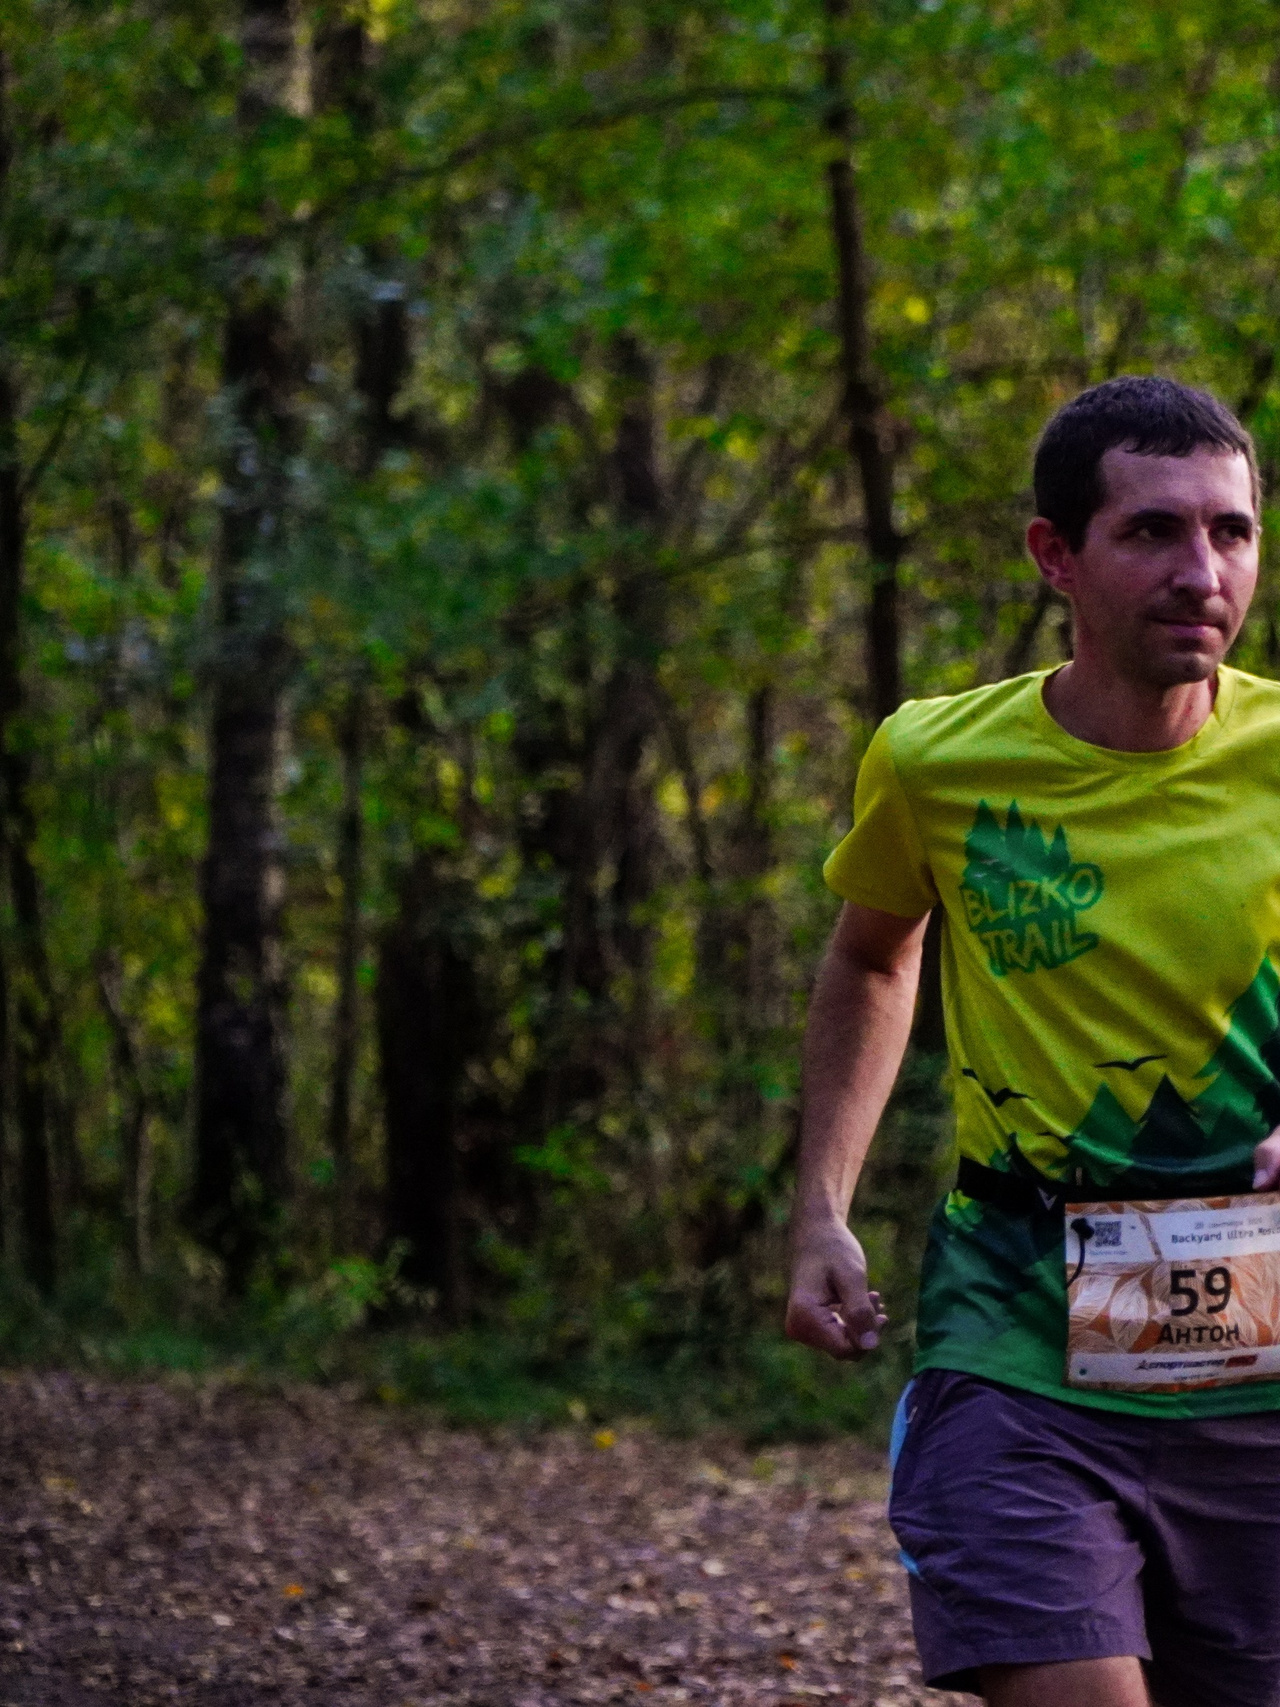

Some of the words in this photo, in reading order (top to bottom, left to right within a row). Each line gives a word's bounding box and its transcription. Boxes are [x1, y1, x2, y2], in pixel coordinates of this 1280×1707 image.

[963, 868, 1101, 925] BLIZKO
[981, 921, 1090, 967] TRAIL
[1171, 1232, 1222, 1245] Backyard
[1227, 1229, 1254, 1240] Ultra
[1171, 1267, 1232, 1316] 59
